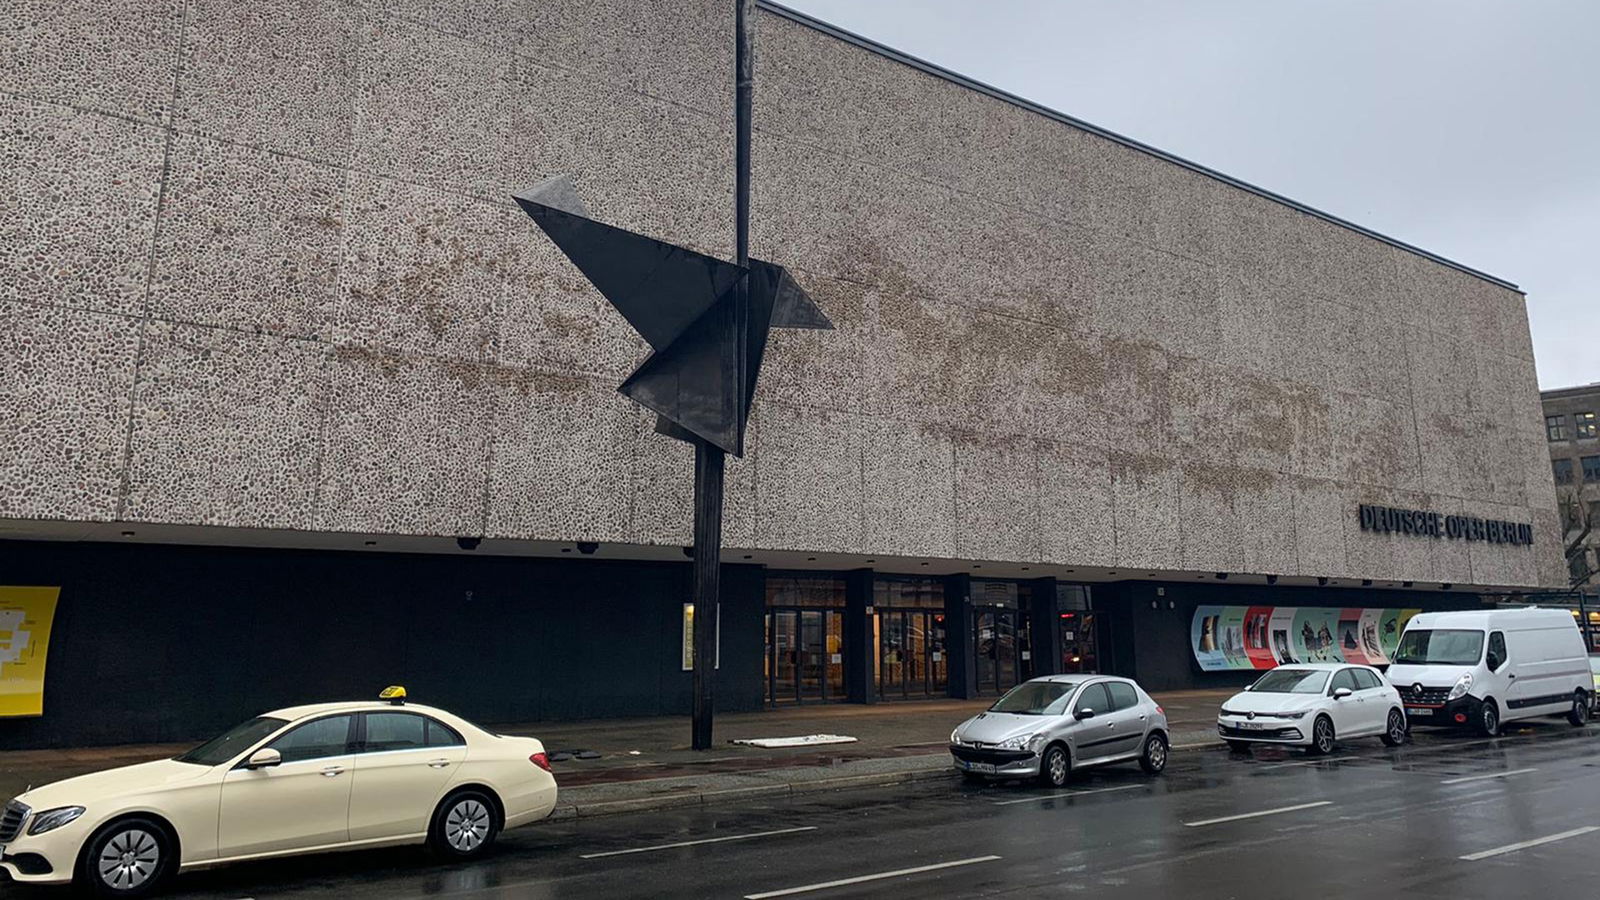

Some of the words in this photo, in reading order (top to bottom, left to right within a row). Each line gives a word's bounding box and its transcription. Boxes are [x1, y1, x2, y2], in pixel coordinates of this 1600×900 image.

[1359, 504, 1445, 538] DEUTSCHE
[1445, 515, 1486, 541] OPER
[1486, 519, 1533, 545] BERLIN
